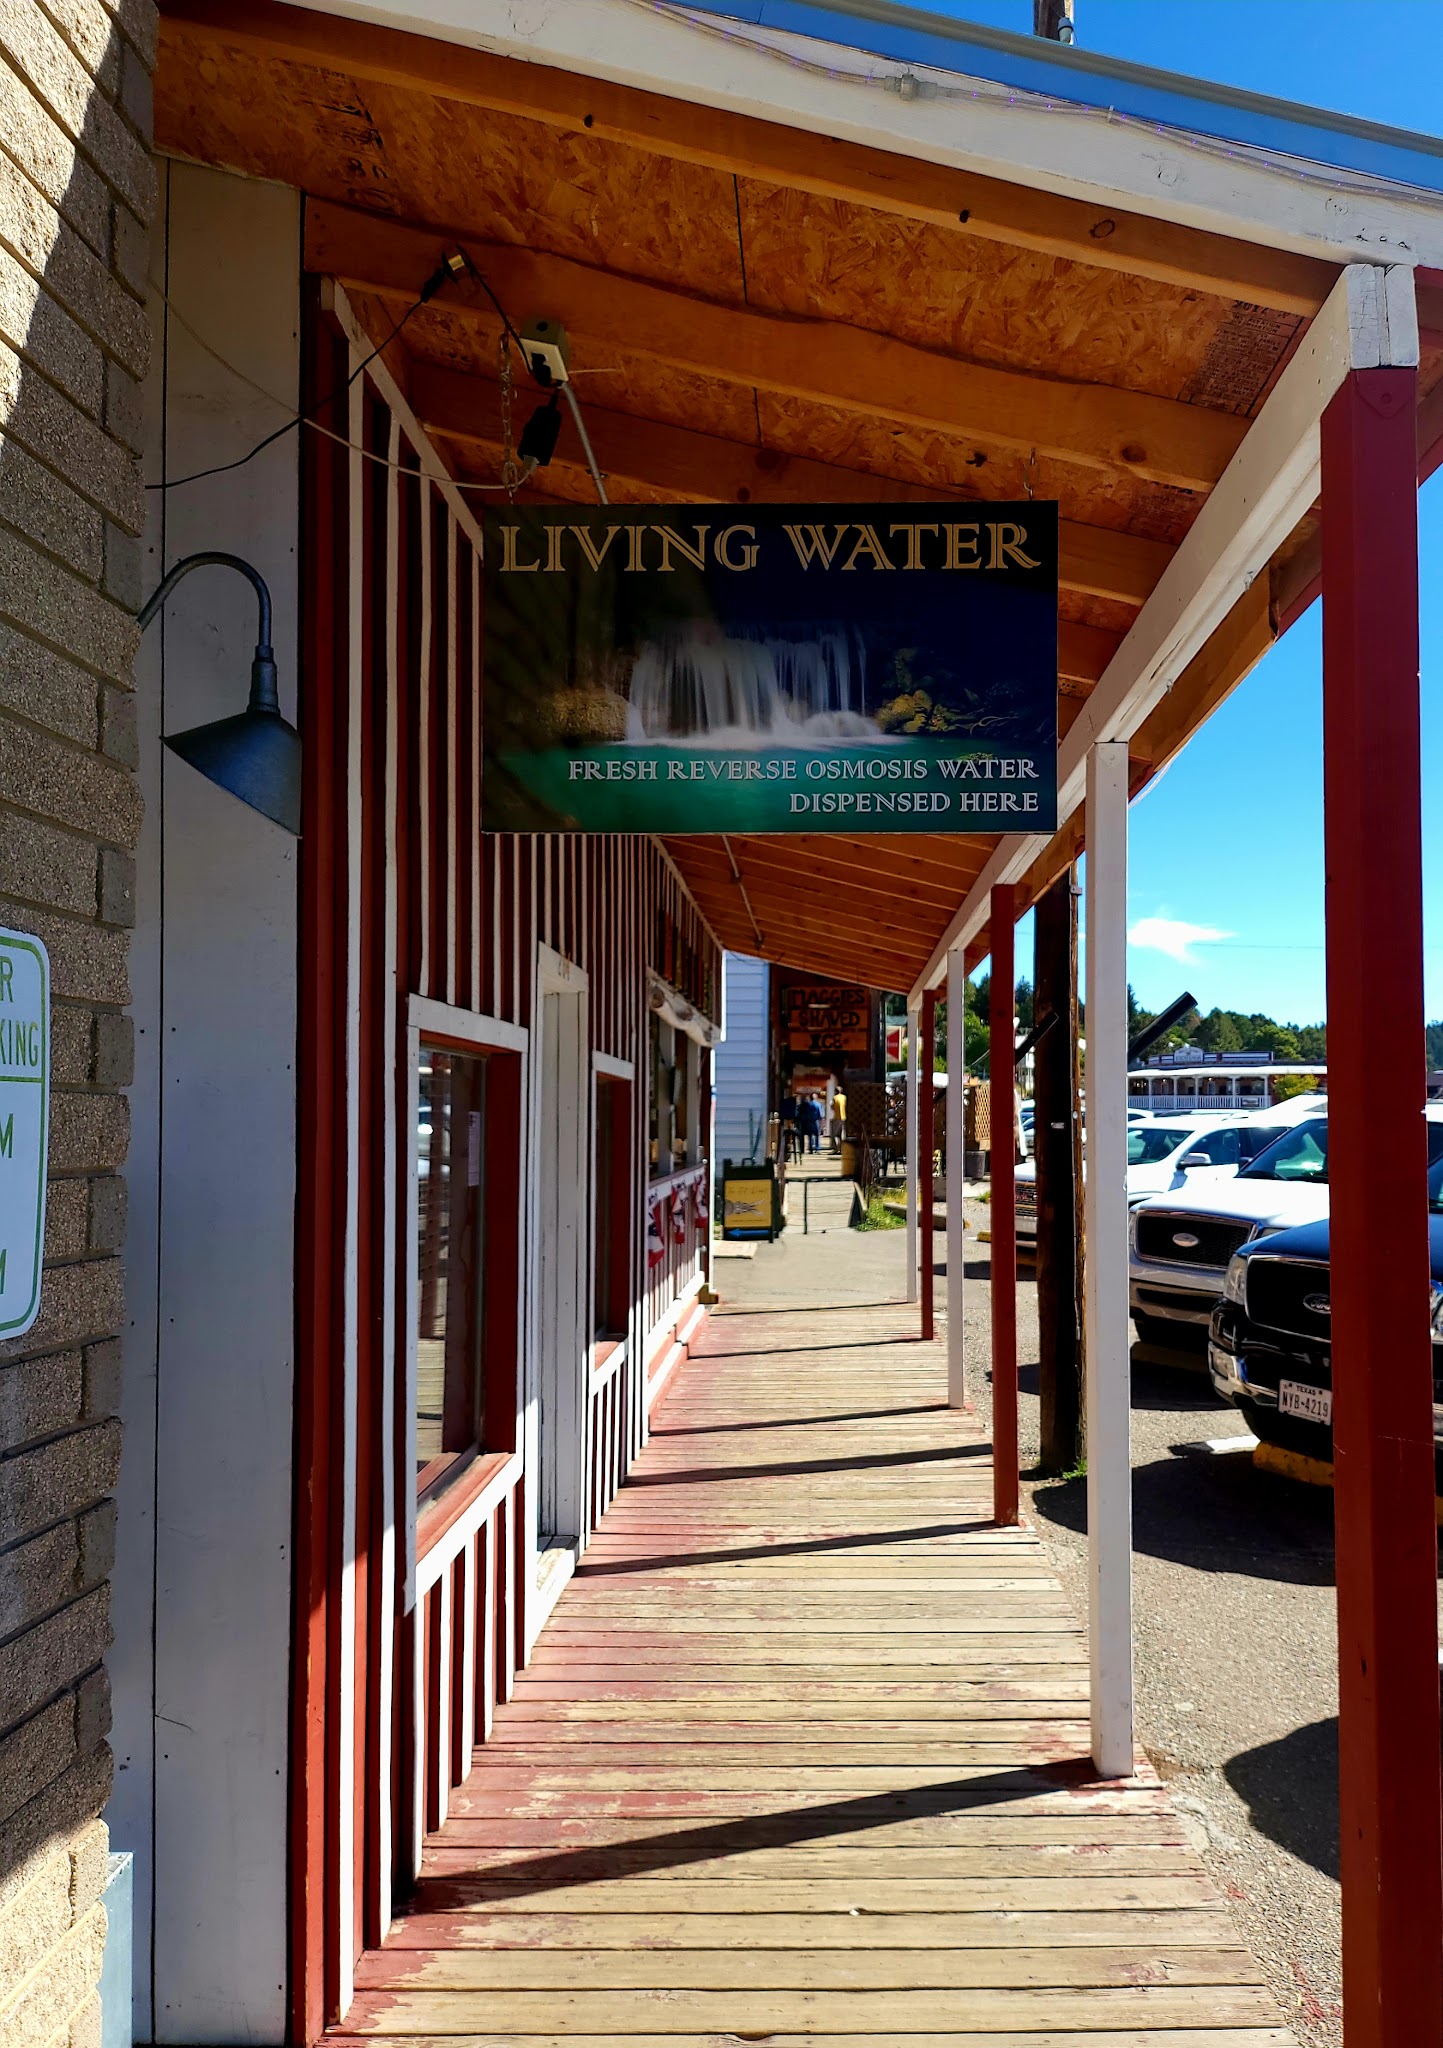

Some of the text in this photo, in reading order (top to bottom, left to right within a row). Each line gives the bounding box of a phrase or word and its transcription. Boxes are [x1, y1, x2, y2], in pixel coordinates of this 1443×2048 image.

[499, 523, 1041, 572] LIVING WATER
[568, 759, 1039, 780] FRESH REVERSE OSMOSIS WATER
[789, 792, 1039, 814] DISPENSED HERE
[799, 1009, 860, 1029] SHAVED
[808, 1033, 843, 1050] ICE
[1296, 1385, 1316, 1396] TEXAS
